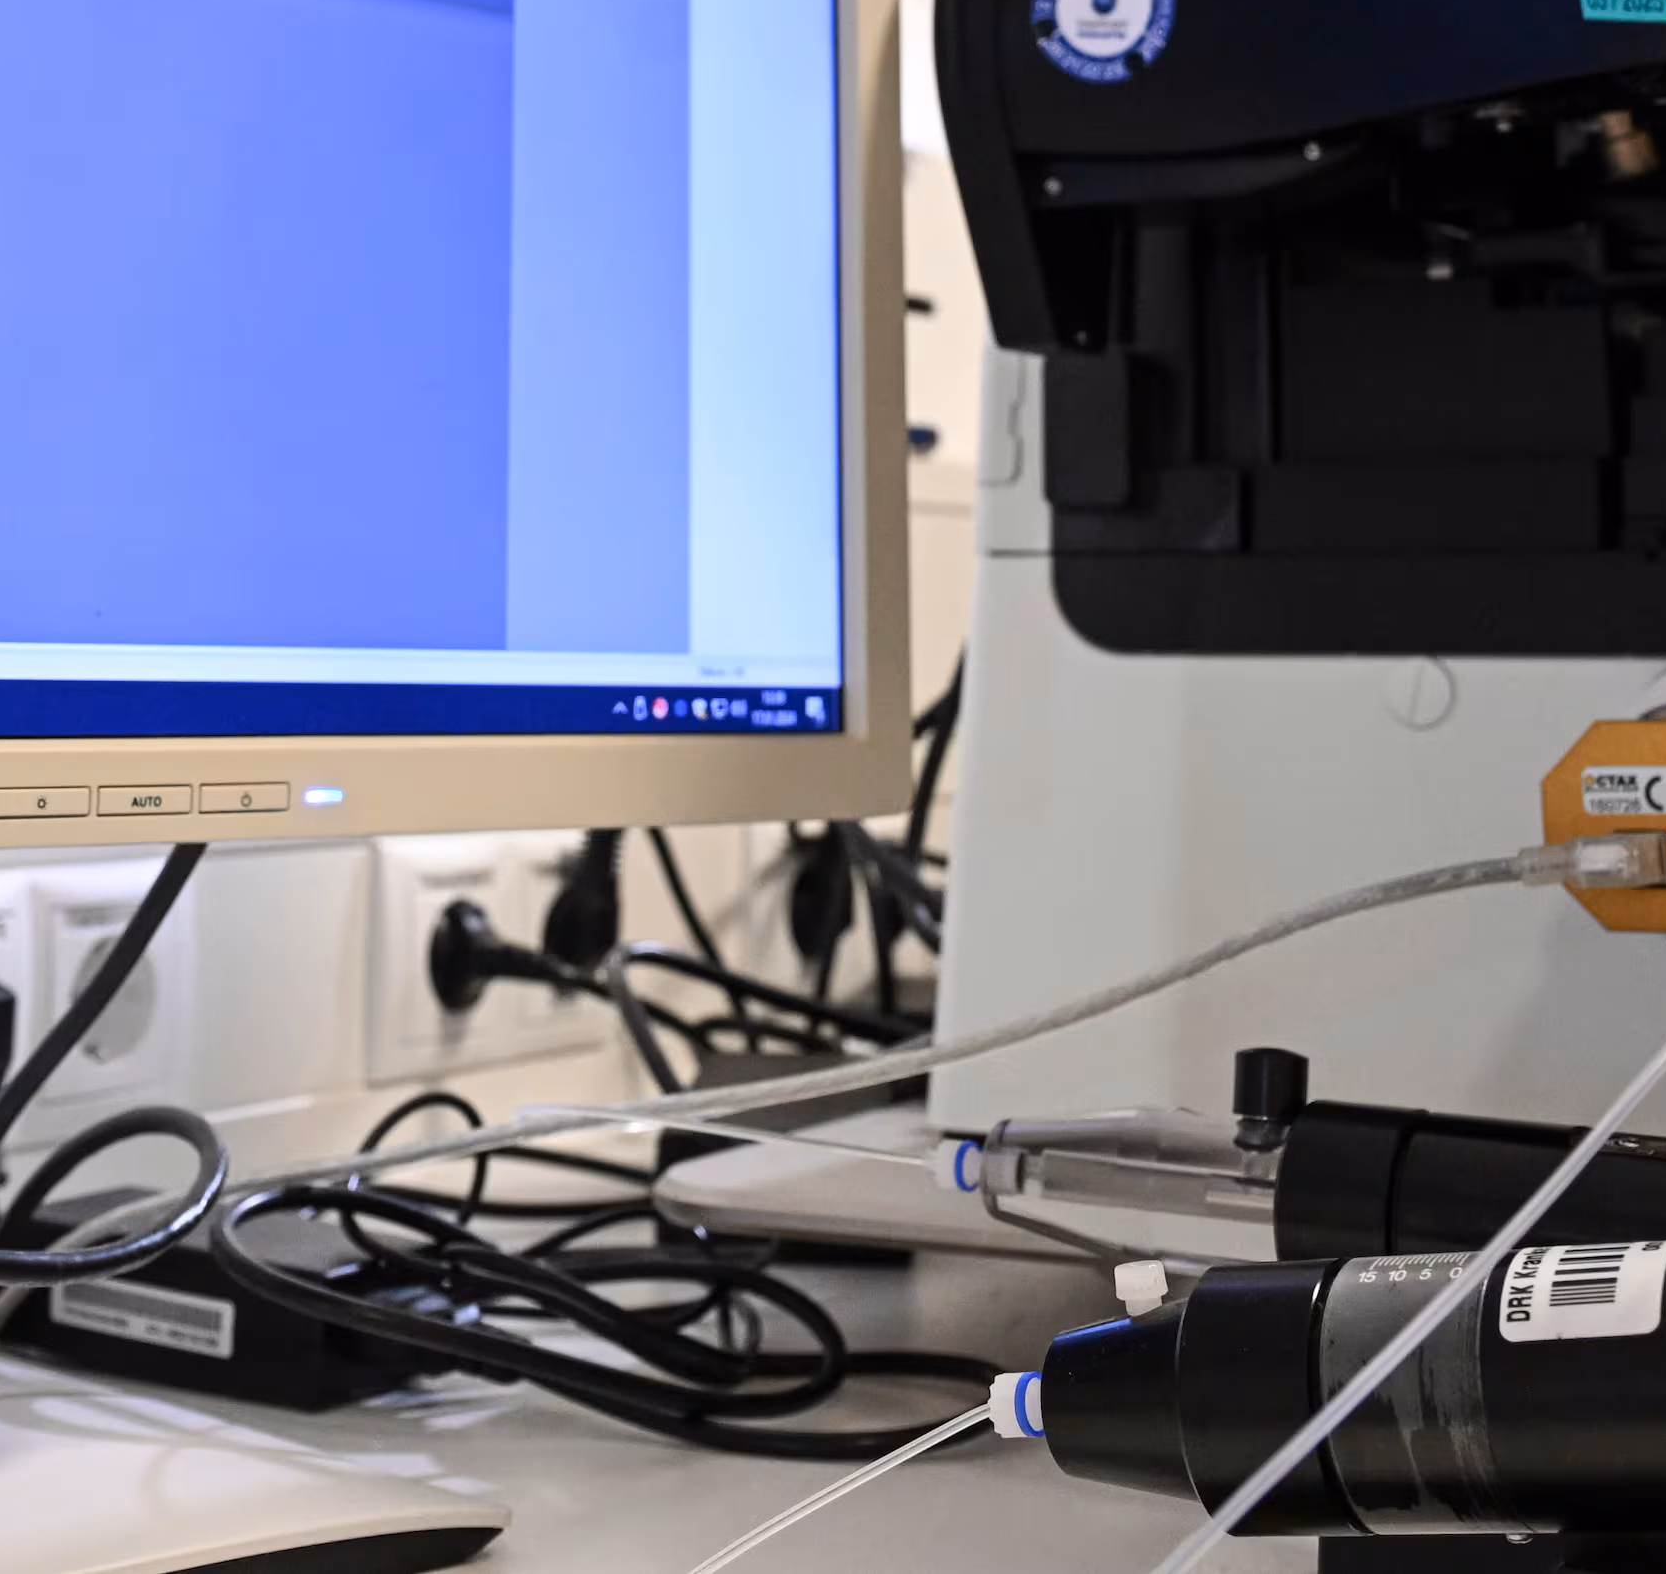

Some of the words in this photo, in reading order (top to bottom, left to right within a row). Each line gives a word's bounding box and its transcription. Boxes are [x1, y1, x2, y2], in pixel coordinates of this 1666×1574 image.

[131, 795, 163, 808] AUTO
[1358, 1271, 1377, 1283] 15
[1388, 1269, 1408, 1282] 10
[1419, 1268, 1432, 1281] 5
[1449, 1267, 1464, 1279] 0
[1506, 1285, 1534, 1323] DRK
